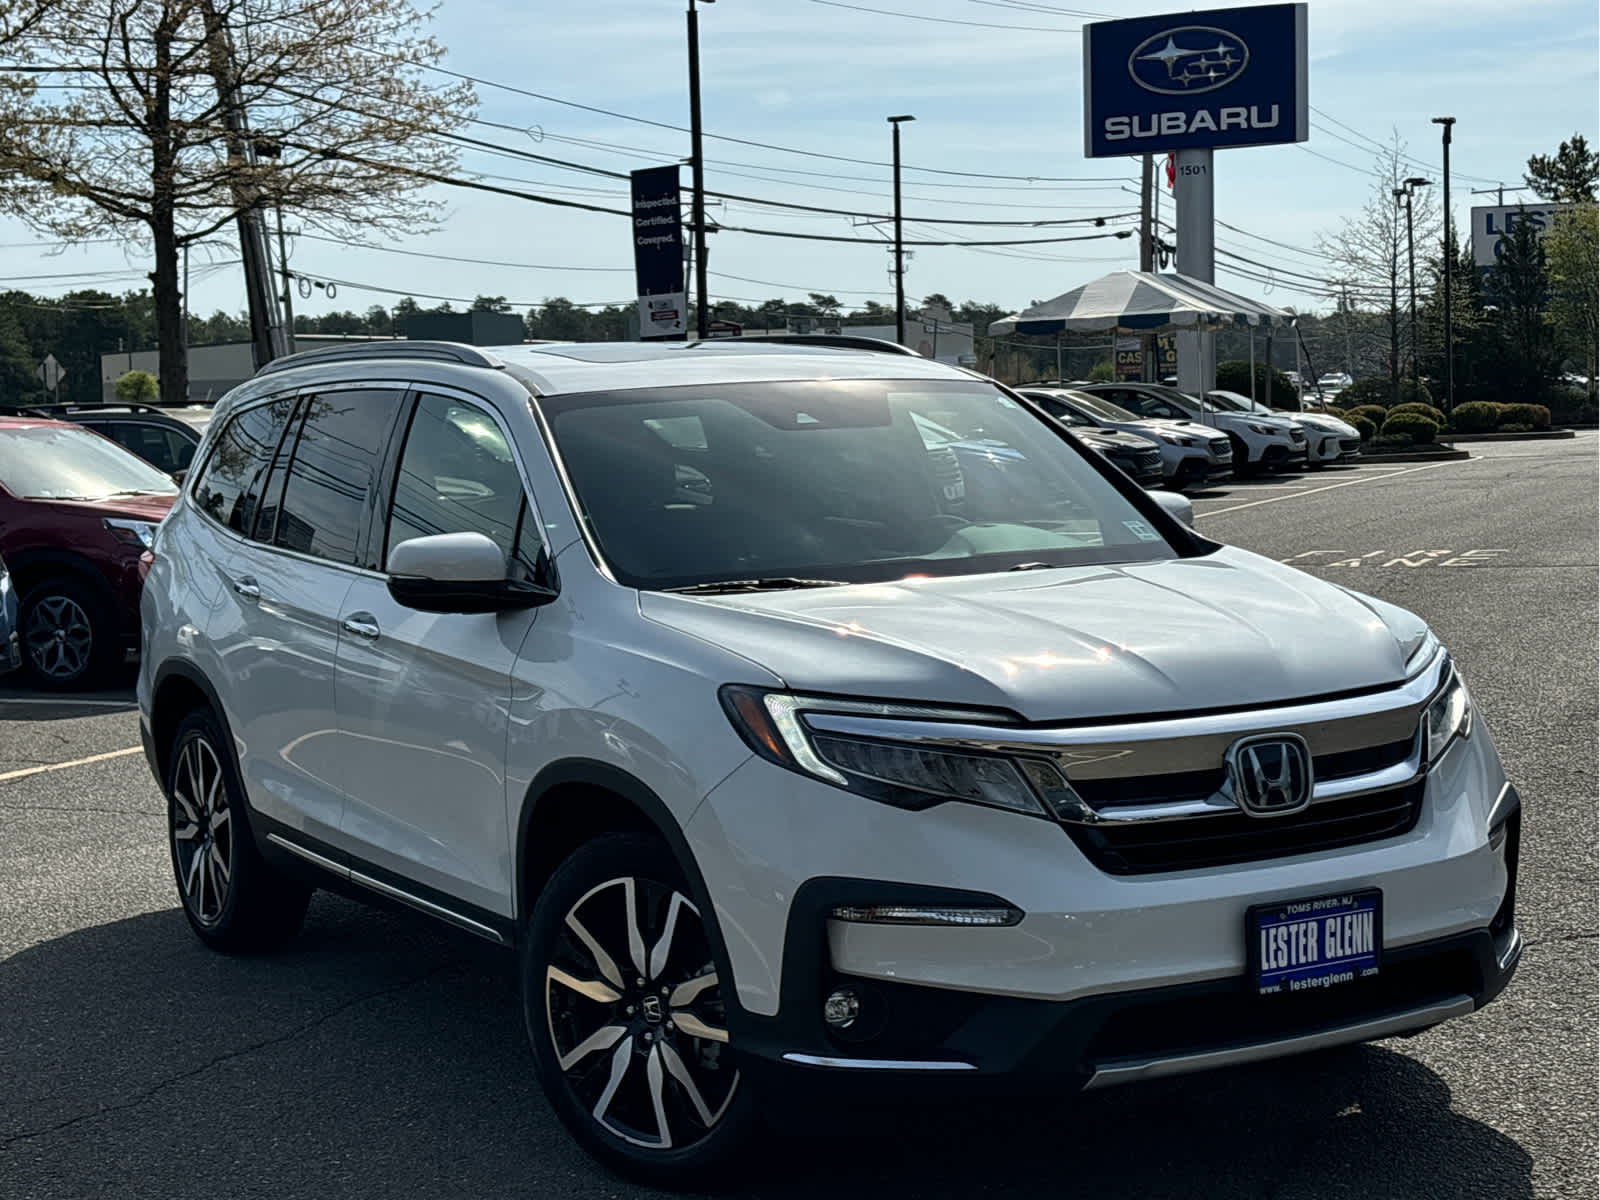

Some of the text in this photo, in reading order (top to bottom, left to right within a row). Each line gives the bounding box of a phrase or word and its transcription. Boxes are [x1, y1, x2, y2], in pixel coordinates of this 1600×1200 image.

[1104, 104, 1280, 140] SUBARU
[1179, 165, 1207, 176] 1501
[635, 215, 676, 227] Certified.
[637, 234, 676, 246] Covered.
[1287, 903, 1311, 914] TOMS
[1341, 896, 1353, 906] NJ
[1261, 911, 1374, 970] LESTER GLENN
[1290, 972, 1354, 991] lesterglenn
